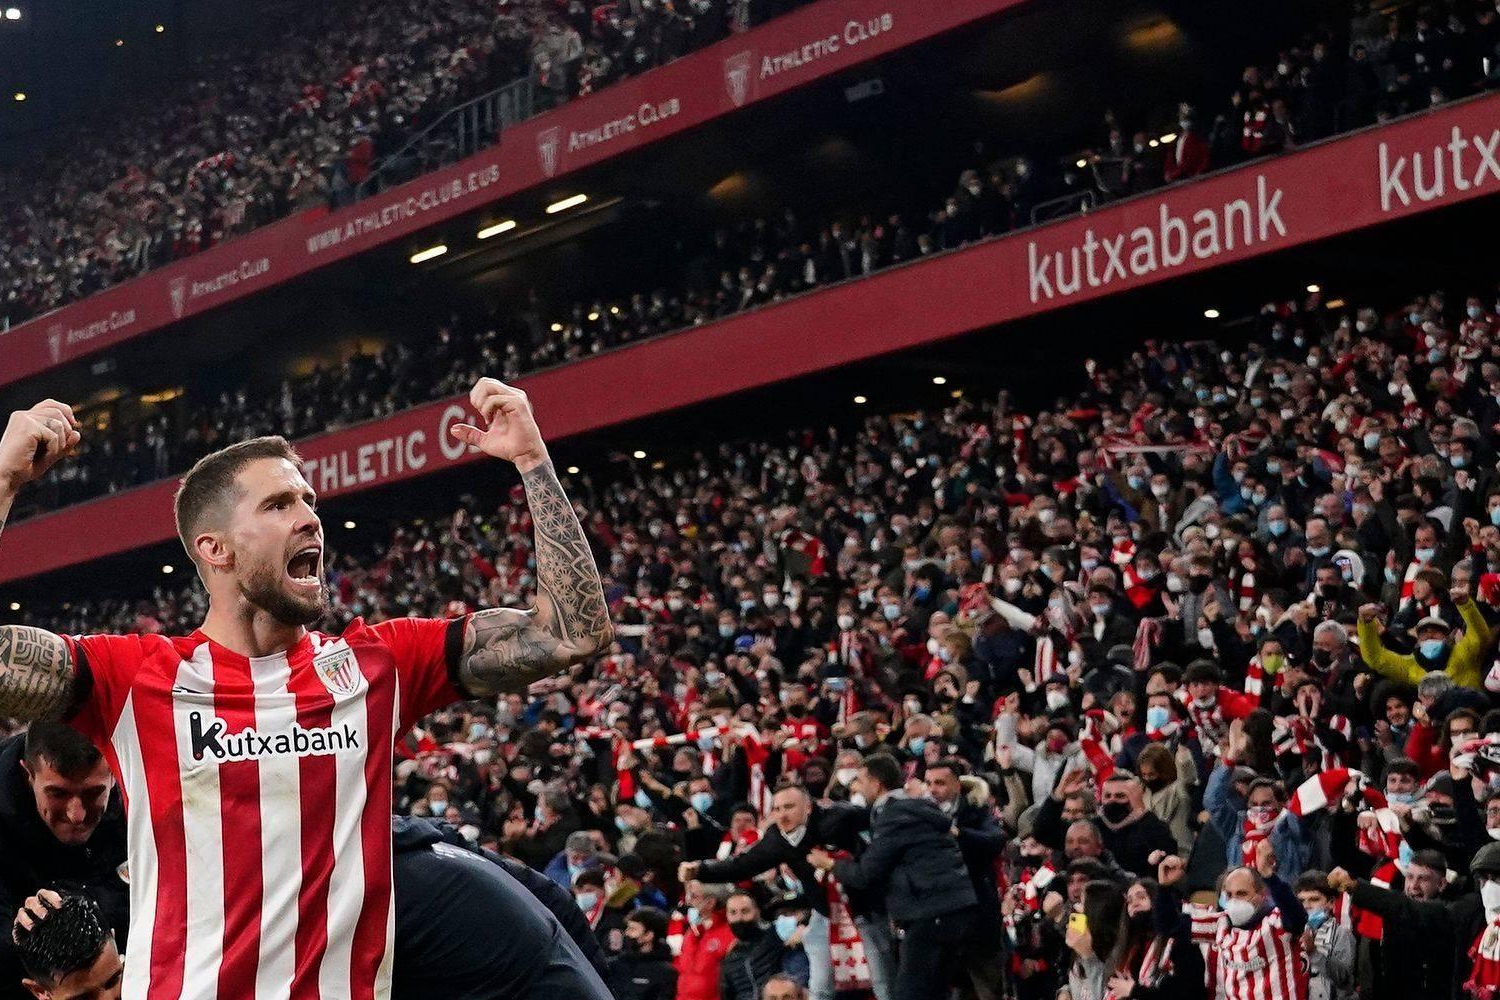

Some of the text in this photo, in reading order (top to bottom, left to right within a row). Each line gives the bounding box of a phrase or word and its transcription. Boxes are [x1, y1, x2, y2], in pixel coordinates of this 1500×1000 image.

[1027, 174, 1286, 303] kutxabank
[299, 430, 428, 494] THLETIC
[189, 711, 359, 761] Kutxabank
